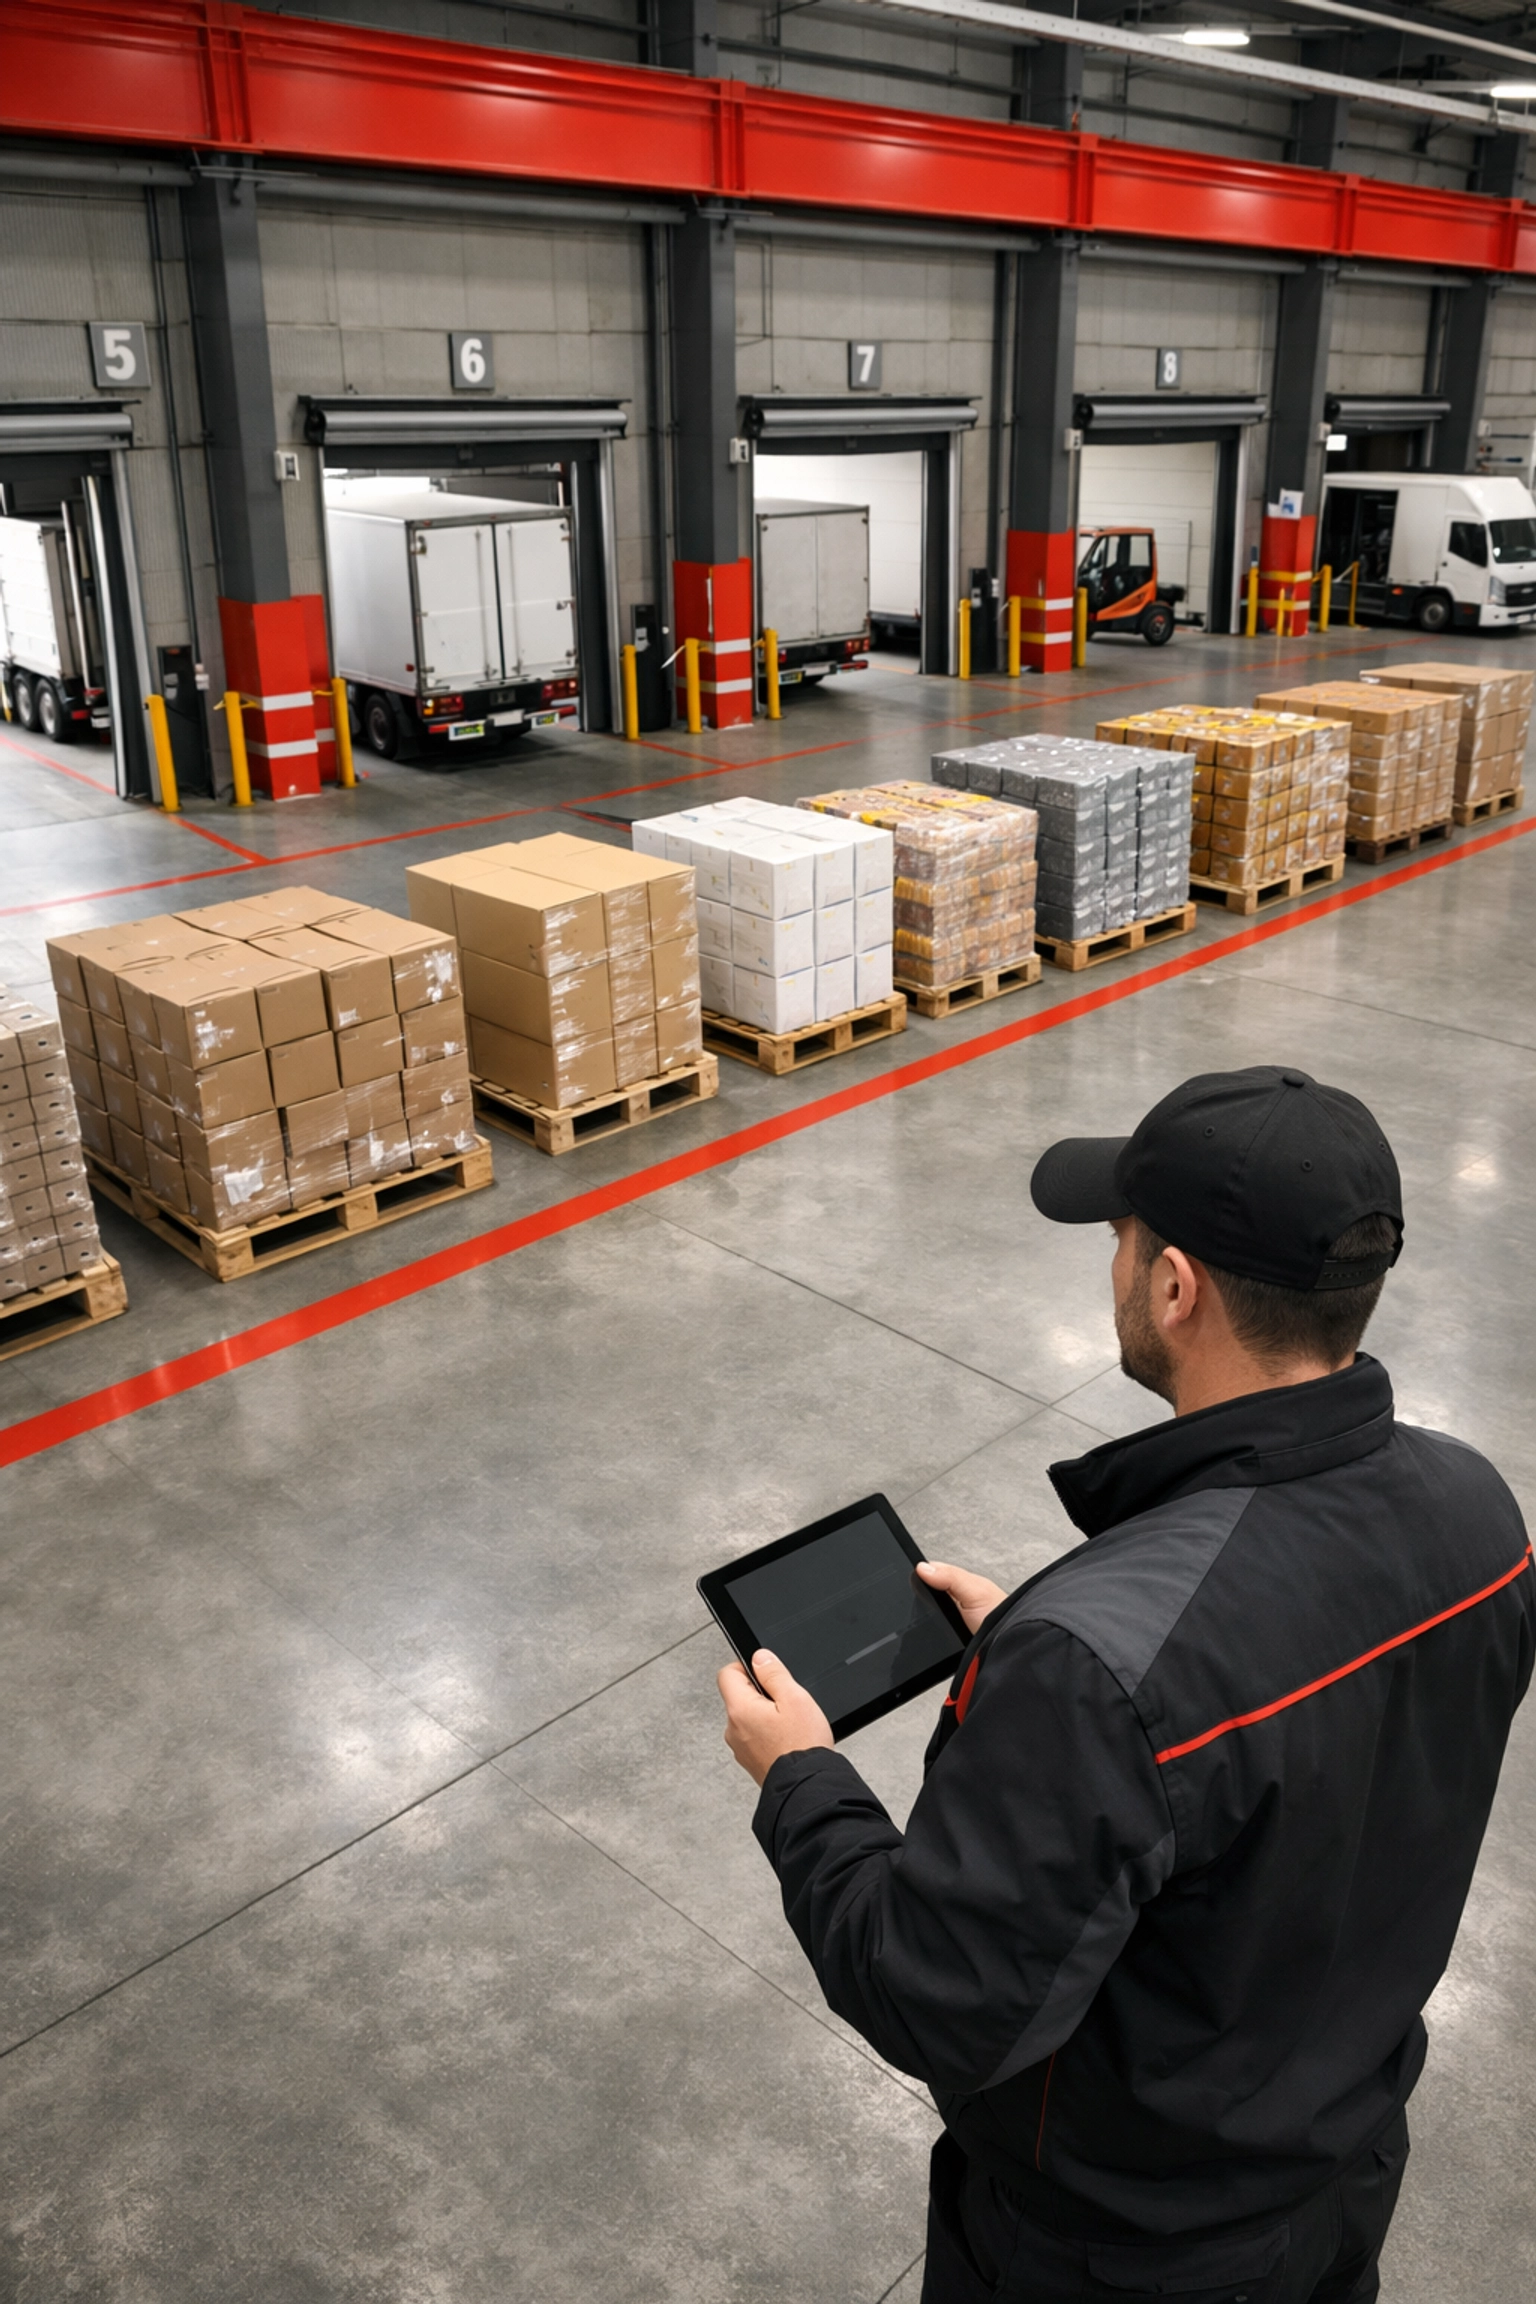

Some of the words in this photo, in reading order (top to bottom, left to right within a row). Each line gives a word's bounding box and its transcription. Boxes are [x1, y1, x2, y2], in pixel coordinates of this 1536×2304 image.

[103, 329, 136, 380] 5
[460, 338, 486, 383] 6
[856, 345, 876, 383] 7
[1163, 351, 1177, 384] 8
